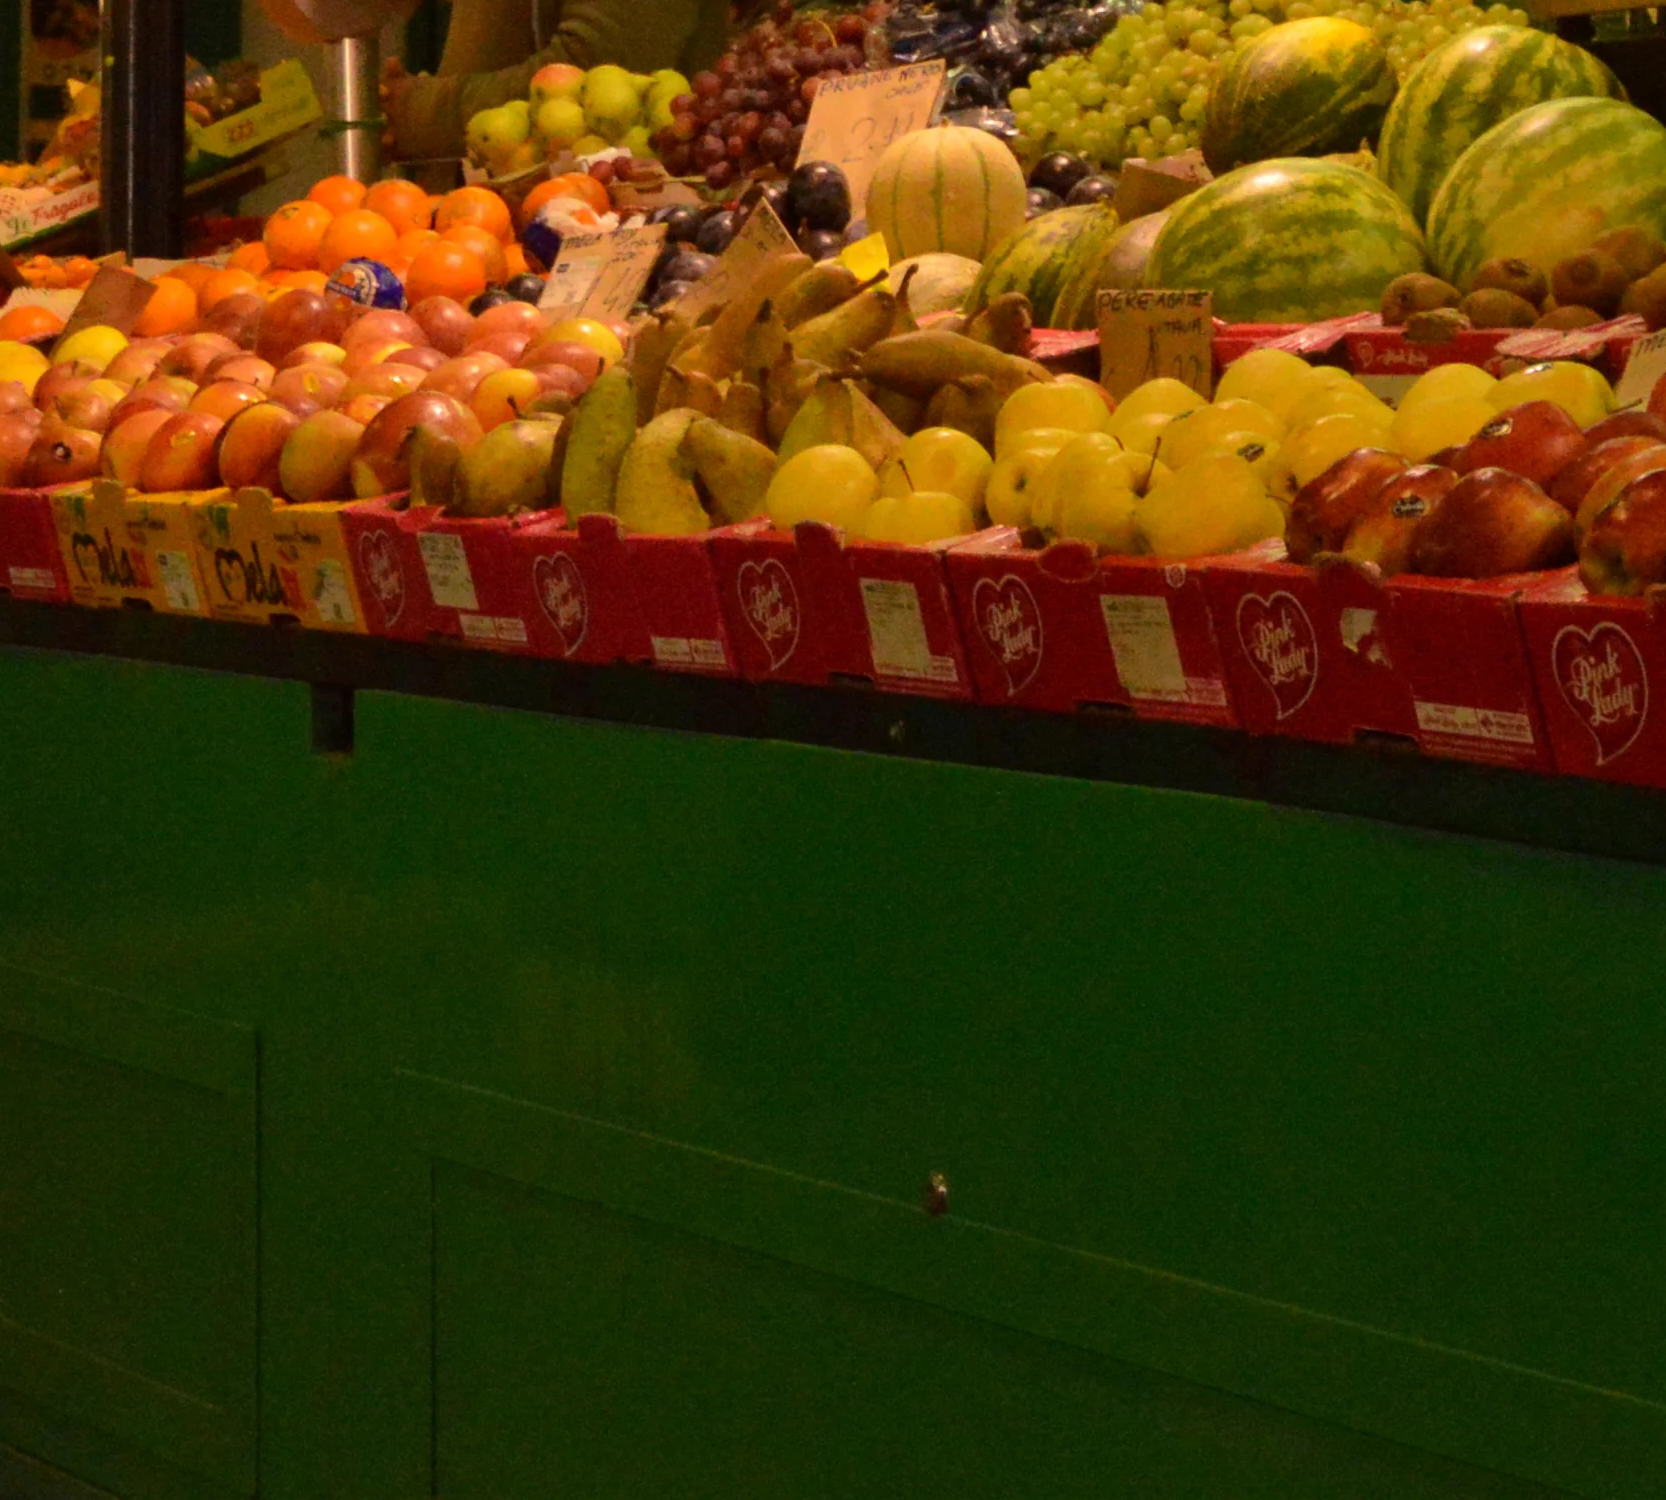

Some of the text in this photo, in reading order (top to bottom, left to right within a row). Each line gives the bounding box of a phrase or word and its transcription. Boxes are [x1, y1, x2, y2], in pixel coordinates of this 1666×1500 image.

[984, 591, 1023, 641] Pink
[1247, 607, 1295, 663] Pink
[1001, 622, 1037, 663] Lady
[1269, 642, 1310, 685] Lady
[1565, 640, 1622, 701] Pink
[1588, 677, 1638, 726] Lady
